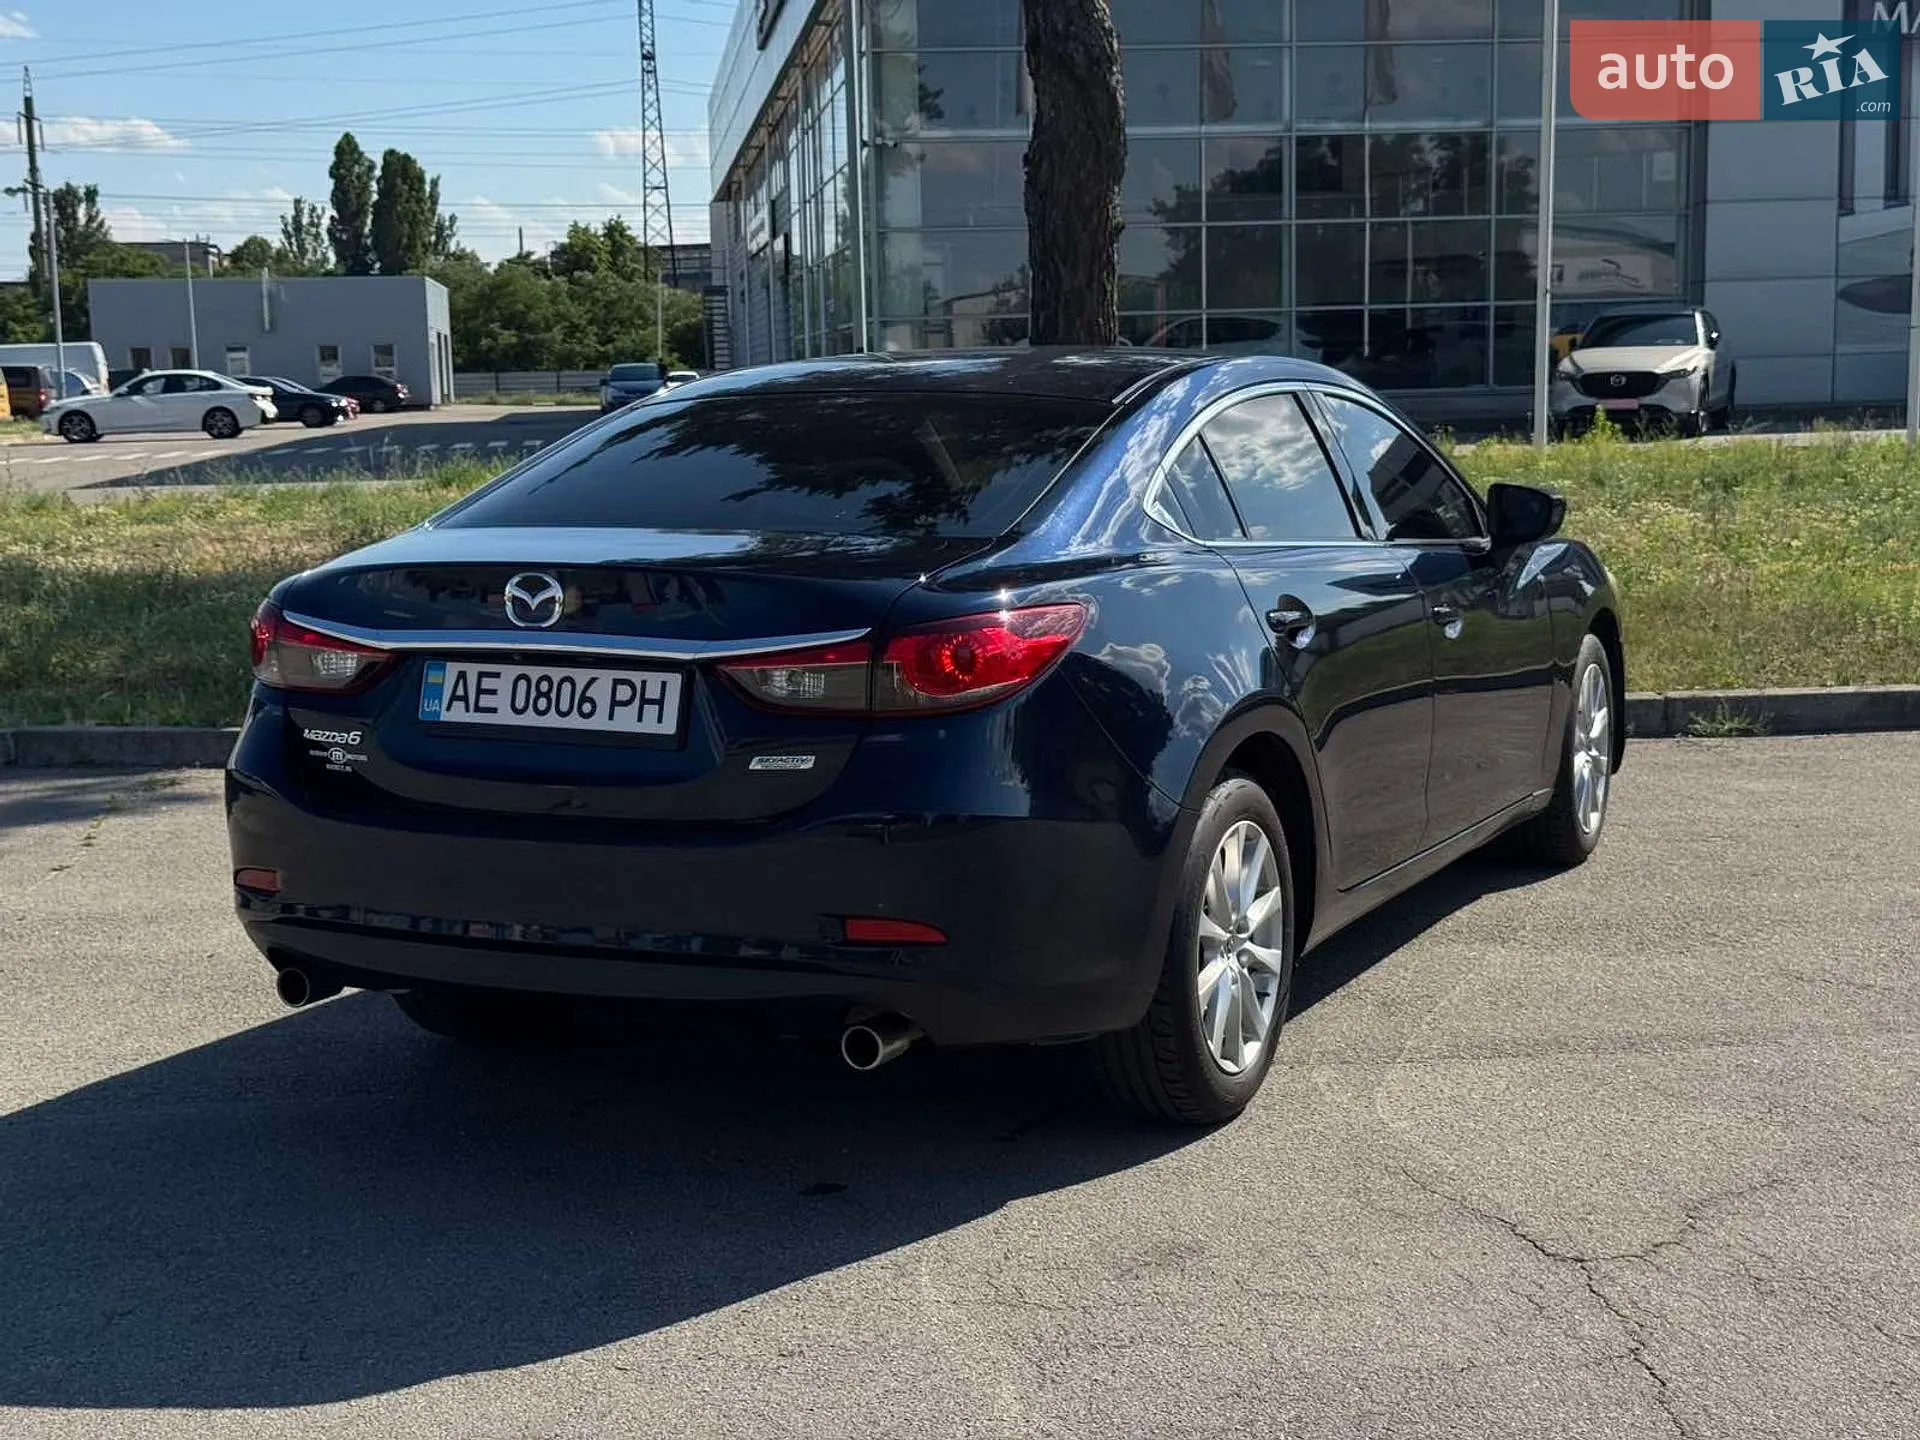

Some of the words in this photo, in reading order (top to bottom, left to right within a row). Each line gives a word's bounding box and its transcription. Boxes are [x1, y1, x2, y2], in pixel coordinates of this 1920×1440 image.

[423, 700, 441, 712] UA
[446, 670, 501, 714] AE
[510, 672, 599, 719] 0806
[607, 678, 668, 724] PH
